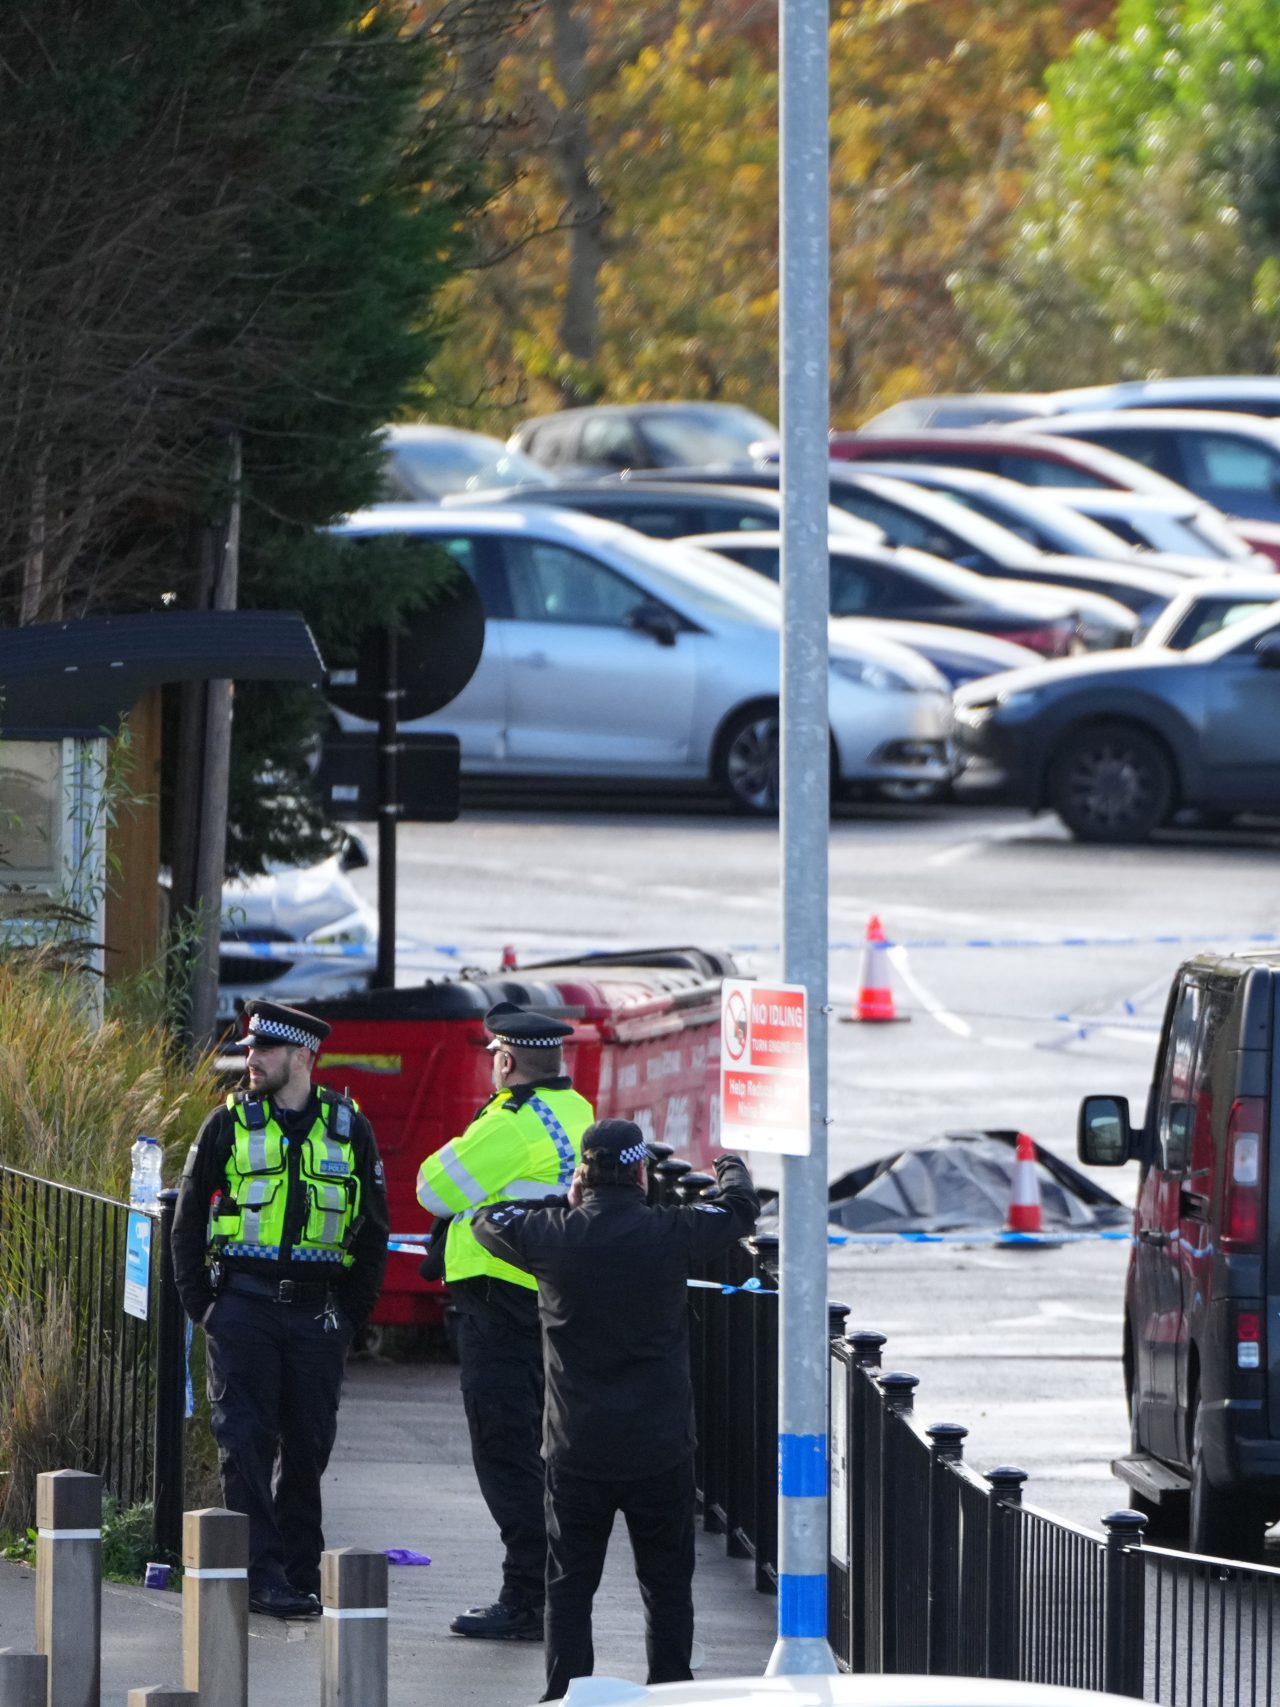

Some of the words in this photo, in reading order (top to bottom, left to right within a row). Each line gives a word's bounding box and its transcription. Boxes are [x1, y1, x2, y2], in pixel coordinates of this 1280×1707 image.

[752, 1003, 767, 1026] NO
[769, 1005, 803, 1028] IDLING
[752, 1038, 768, 1051] TURN
[729, 1079, 746, 1096] Help
